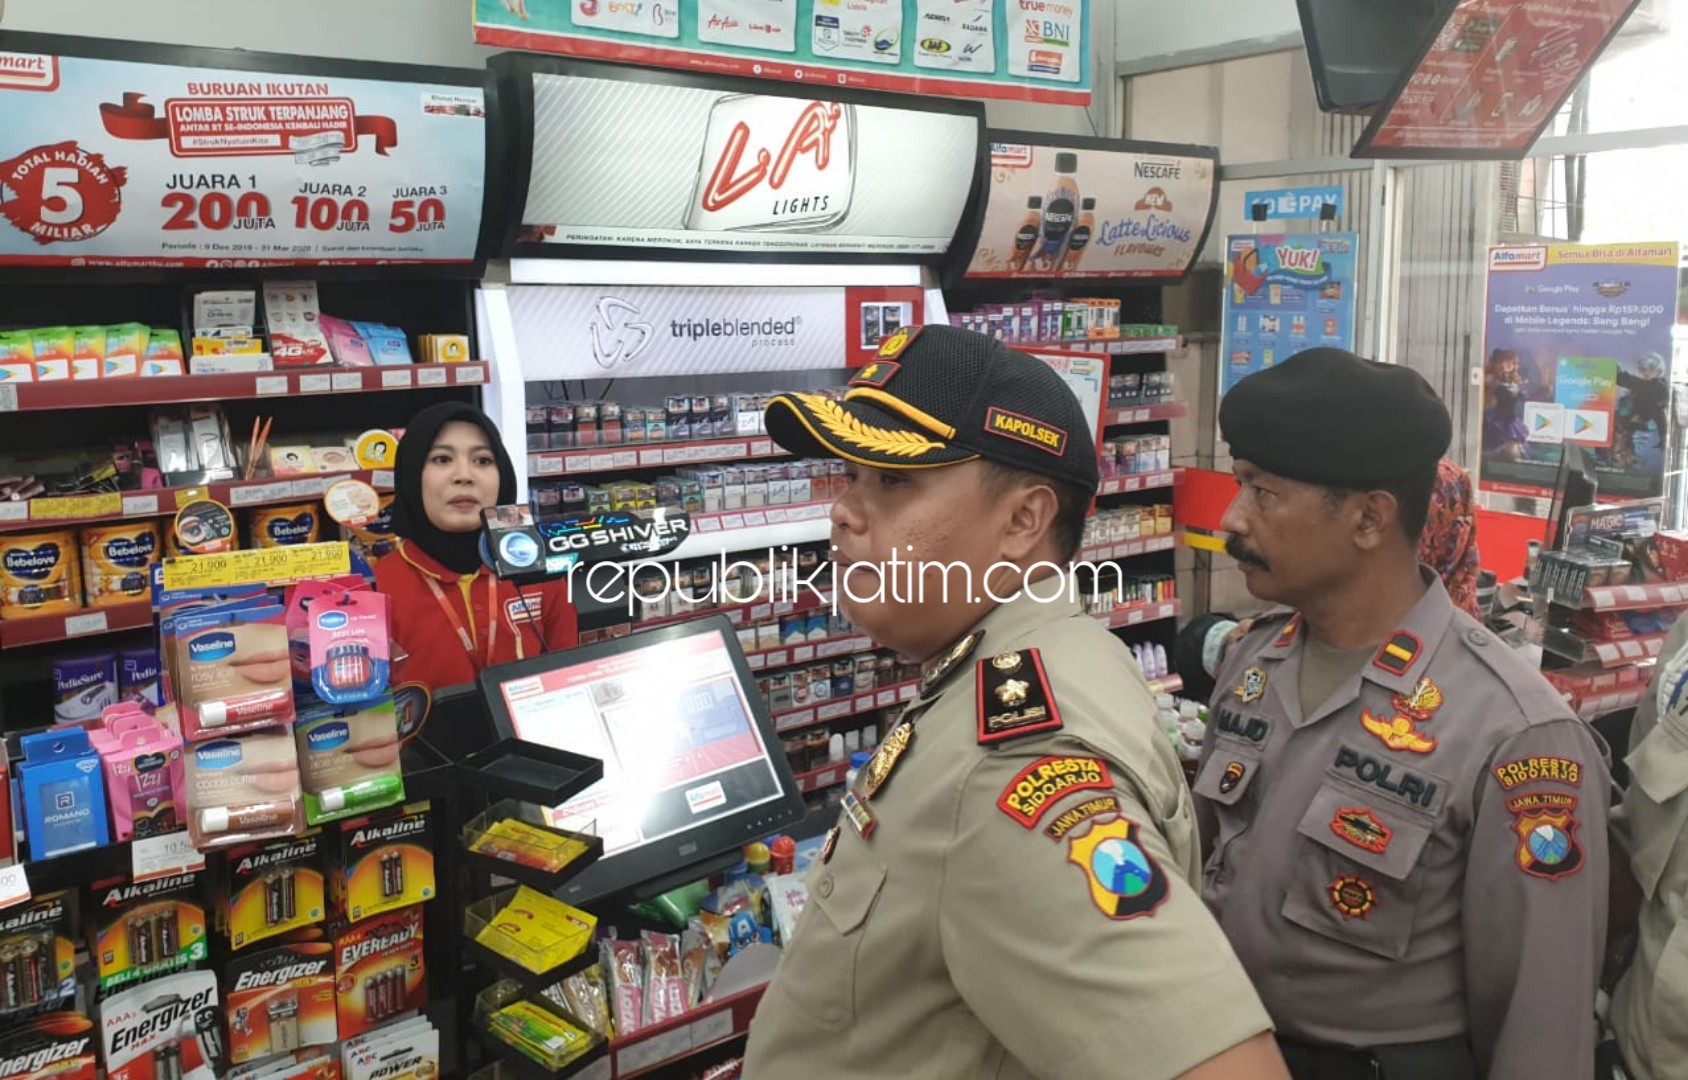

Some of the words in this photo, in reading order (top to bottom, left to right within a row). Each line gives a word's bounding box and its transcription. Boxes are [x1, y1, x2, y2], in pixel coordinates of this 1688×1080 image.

[1043, 20, 1069, 41] BNI
[187, 82, 262, 96] BURUAN
[266, 83, 329, 96] IKUTAN
[176, 106, 221, 122] LOMBA
[226, 106, 267, 121] STRUK
[269, 105, 348, 120] TERPANJANG
[179, 123, 209, 131] ANTAR
[12, 152, 52, 180] TOTAL
[55, 151, 109, 184] HADIAH
[167, 174, 241, 190] JUARA
[249, 175, 257, 189] 1
[300, 182, 353, 196] JUARA
[358, 186, 367, 197] 2
[393, 187, 437, 198] JUARA
[439, 186, 448, 196] 3
[41, 167, 84, 224] 5
[161, 191, 272, 231] 200
[233, 217, 276, 230] JUTA
[291, 196, 370, 231] 100
[337, 221, 370, 232] JUTA
[389, 198, 445, 233] 50
[772, 196, 830, 216] LIGHTS
[30, 222, 95, 238] MILIAR
[415, 221, 445, 232] JUTA
[1276, 245, 1321, 272] YUK!
[1493, 250, 1541, 262] Alfamart
[1558, 250, 1590, 259] Semua
[1592, 249, 1614, 258] Bisa
[1627, 248, 1672, 257] Alfamart
[1495, 304, 1538, 315] Dapatkan
[1572, 304, 1606, 316] hingga
[671, 316, 795, 342] tripleblended
[1515, 316, 1546, 325] Mobile
[1547, 316, 1591, 327] Legends:
[1593, 316, 1619, 327] Bang
[1621, 316, 1650, 327] Bang!
[752, 338, 795, 348] process
[995, 413, 1060, 448] KAPOLSEK
[549, 533, 591, 552] GG
[591, 518, 689, 546] SHIVER
[6, 554, 55, 567] Bebelove
[190, 637, 234, 654] Vaseline
[58, 670, 104, 690] PediaSure
[132, 668, 157, 681] Pedia
[237, 702, 273, 716] Vaseline
[308, 726, 349, 743] Vaseline
[197, 747, 241, 762] Vaseline
[1334, 744, 1438, 808] POLRI
[1497, 758, 1578, 780] POLRESTA
[1503, 767, 1578, 786] SIDOARJO
[1007, 757, 1101, 811] POLRESTA
[1021, 772, 1101, 816] SIDOARJO
[1513, 796, 1540, 808] JAWA
[1543, 795, 1573, 806] TIMUR
[44, 809, 90, 824] ROMANO
[238, 811, 278, 826] Vaseline
[1051, 809, 1082, 837] JAWA
[1079, 797, 1117, 819] TIMUR
[351, 819, 426, 846] Alkaline
[235, 841, 317, 874] Alkaline
[102, 873, 196, 907] Alkaline
[0, 905, 64, 931] aline
[190, 942, 205, 960] 3
[341, 923, 420, 964] EVEREADY
[234, 959, 327, 991] Energizer
[110, 986, 214, 1055] Energizer
[369, 1055, 423, 1080] POWER
